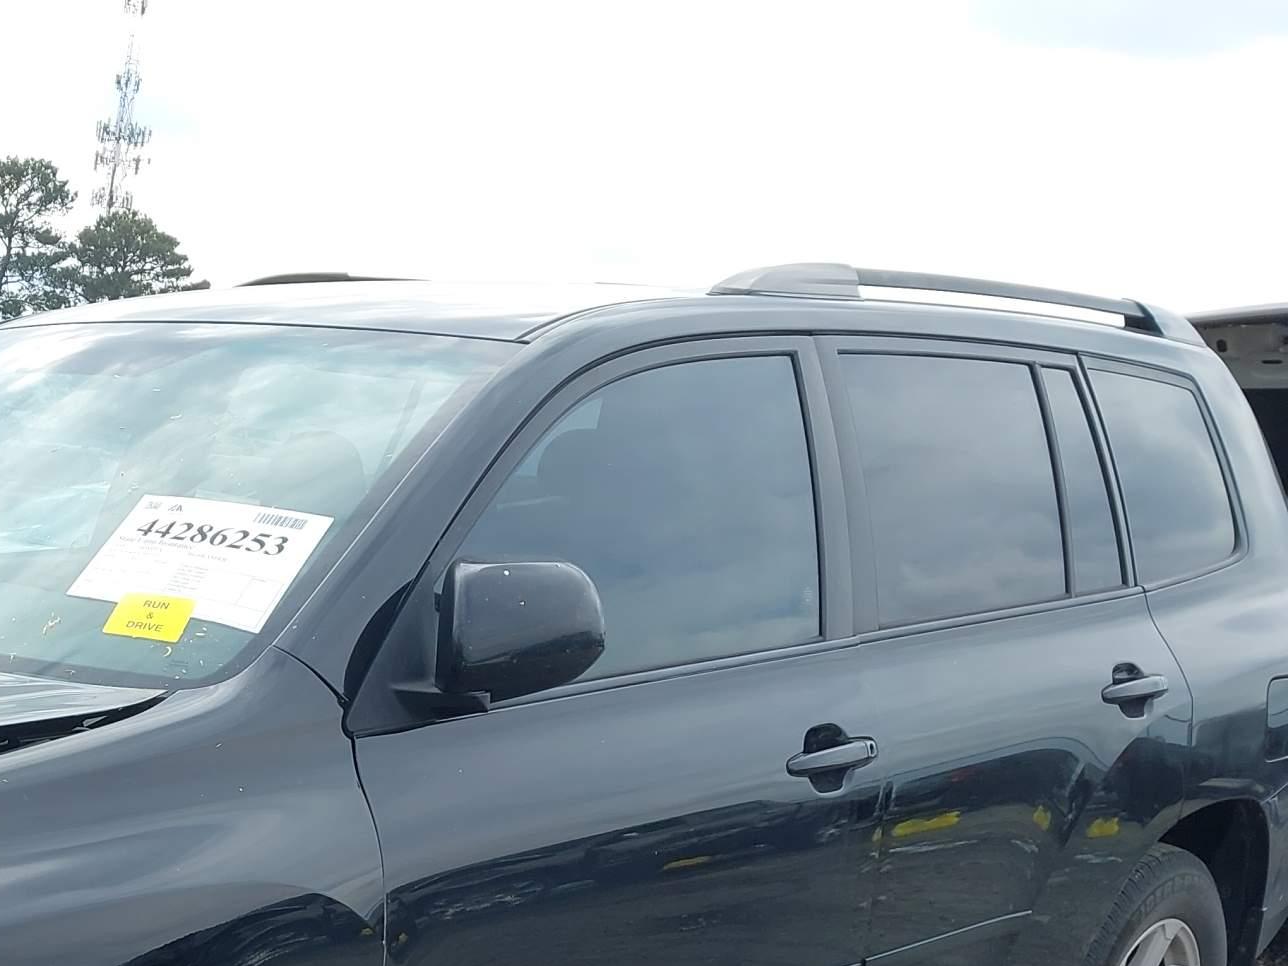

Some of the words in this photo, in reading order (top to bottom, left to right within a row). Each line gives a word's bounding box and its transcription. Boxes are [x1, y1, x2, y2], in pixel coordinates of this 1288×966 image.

[136, 518, 289, 556] 44286253
[143, 600, 170, 609] RUN
[126, 620, 164, 632] DRIVE
